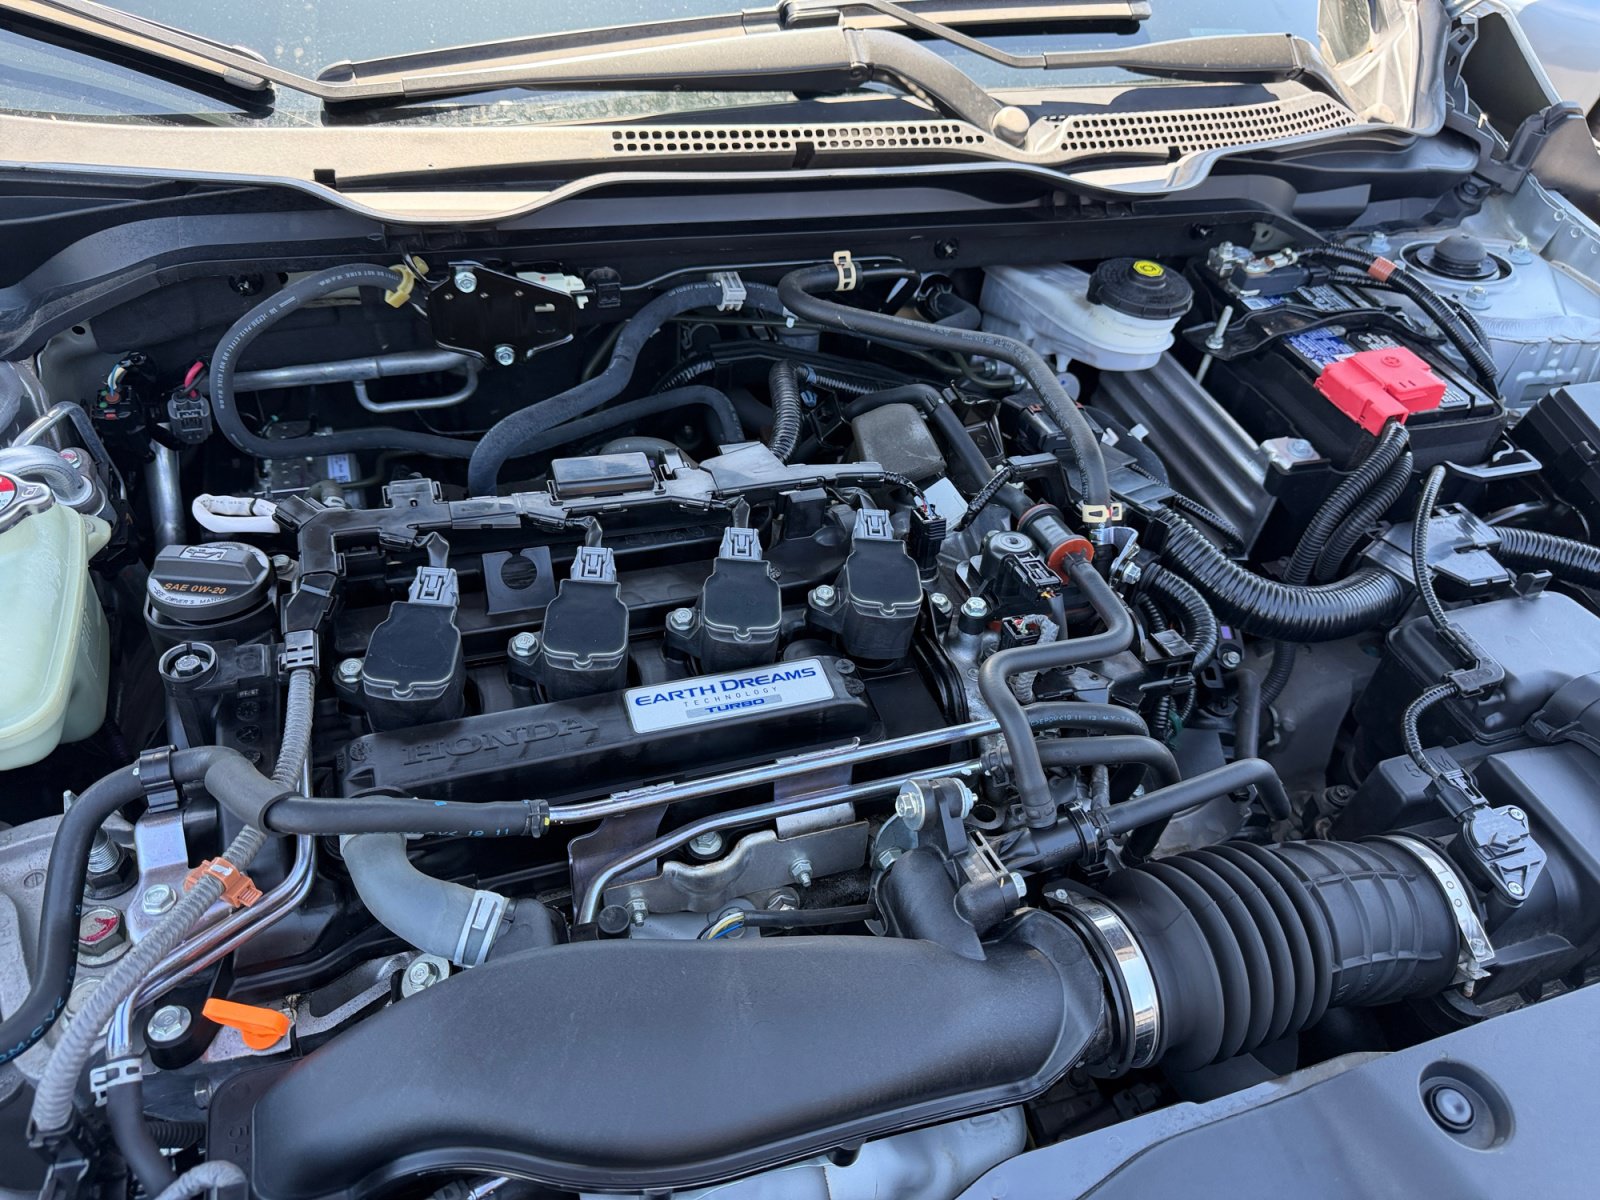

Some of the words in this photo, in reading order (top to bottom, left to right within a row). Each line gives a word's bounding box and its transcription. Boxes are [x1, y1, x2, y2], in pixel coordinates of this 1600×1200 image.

[164, 583, 189, 592] SAE
[191, 585, 227, 594] 0W-20
[635, 684, 716, 706] EARTH
[720, 667, 817, 692] DREAMS
[683, 686, 778, 708] TECHNOLOGY
[705, 698, 765, 713] TURBO
[401, 716, 600, 766] HONDA
